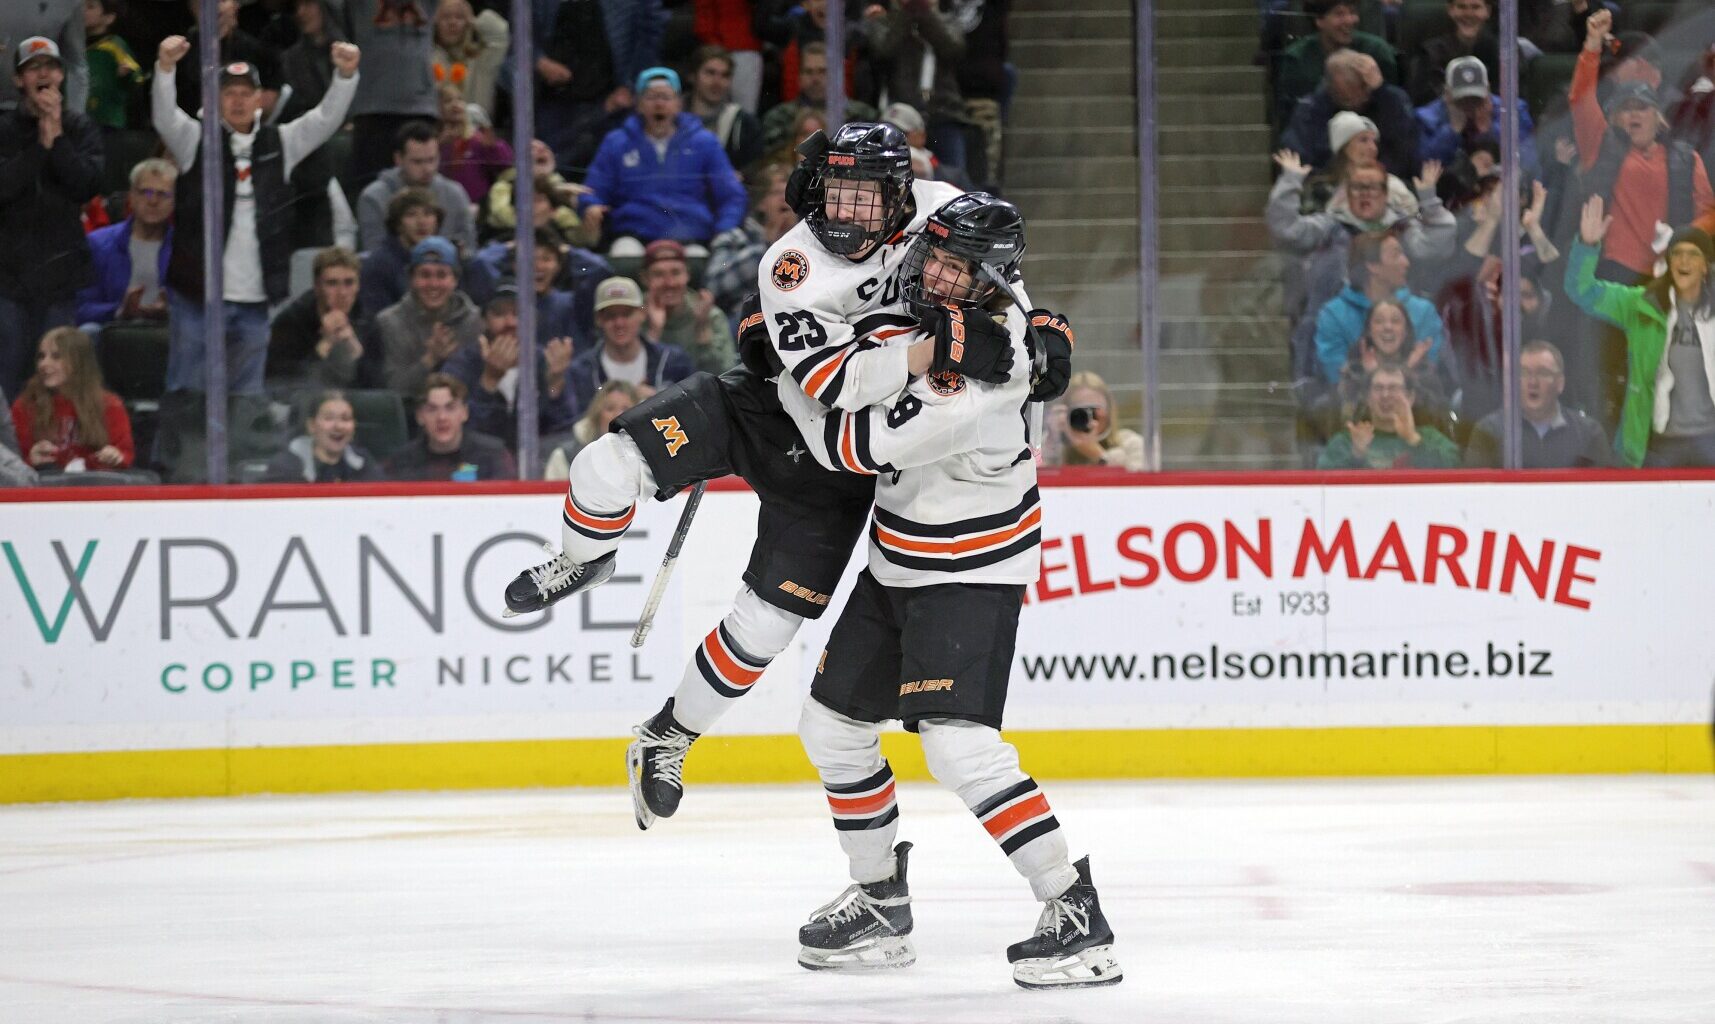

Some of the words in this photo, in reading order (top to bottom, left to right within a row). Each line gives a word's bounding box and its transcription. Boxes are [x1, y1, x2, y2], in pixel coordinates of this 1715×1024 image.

[775, 260, 800, 281] M
[775, 309, 828, 350] 23
[947, 303, 965, 363] BAU
[651, 415, 690, 458] M
[1023, 518, 1273, 605] ELSON
[1292, 518, 1602, 610] MARINE
[778, 580, 832, 606] BAUE
[1232, 591, 1262, 616] Est
[1280, 591, 1330, 616] 1933
[159, 657, 398, 694] COPPER
[437, 652, 654, 686] NICKEL
[1021, 642, 1554, 681] www.nelsonmarine.biz
[1062, 929, 1081, 946] BAUE
